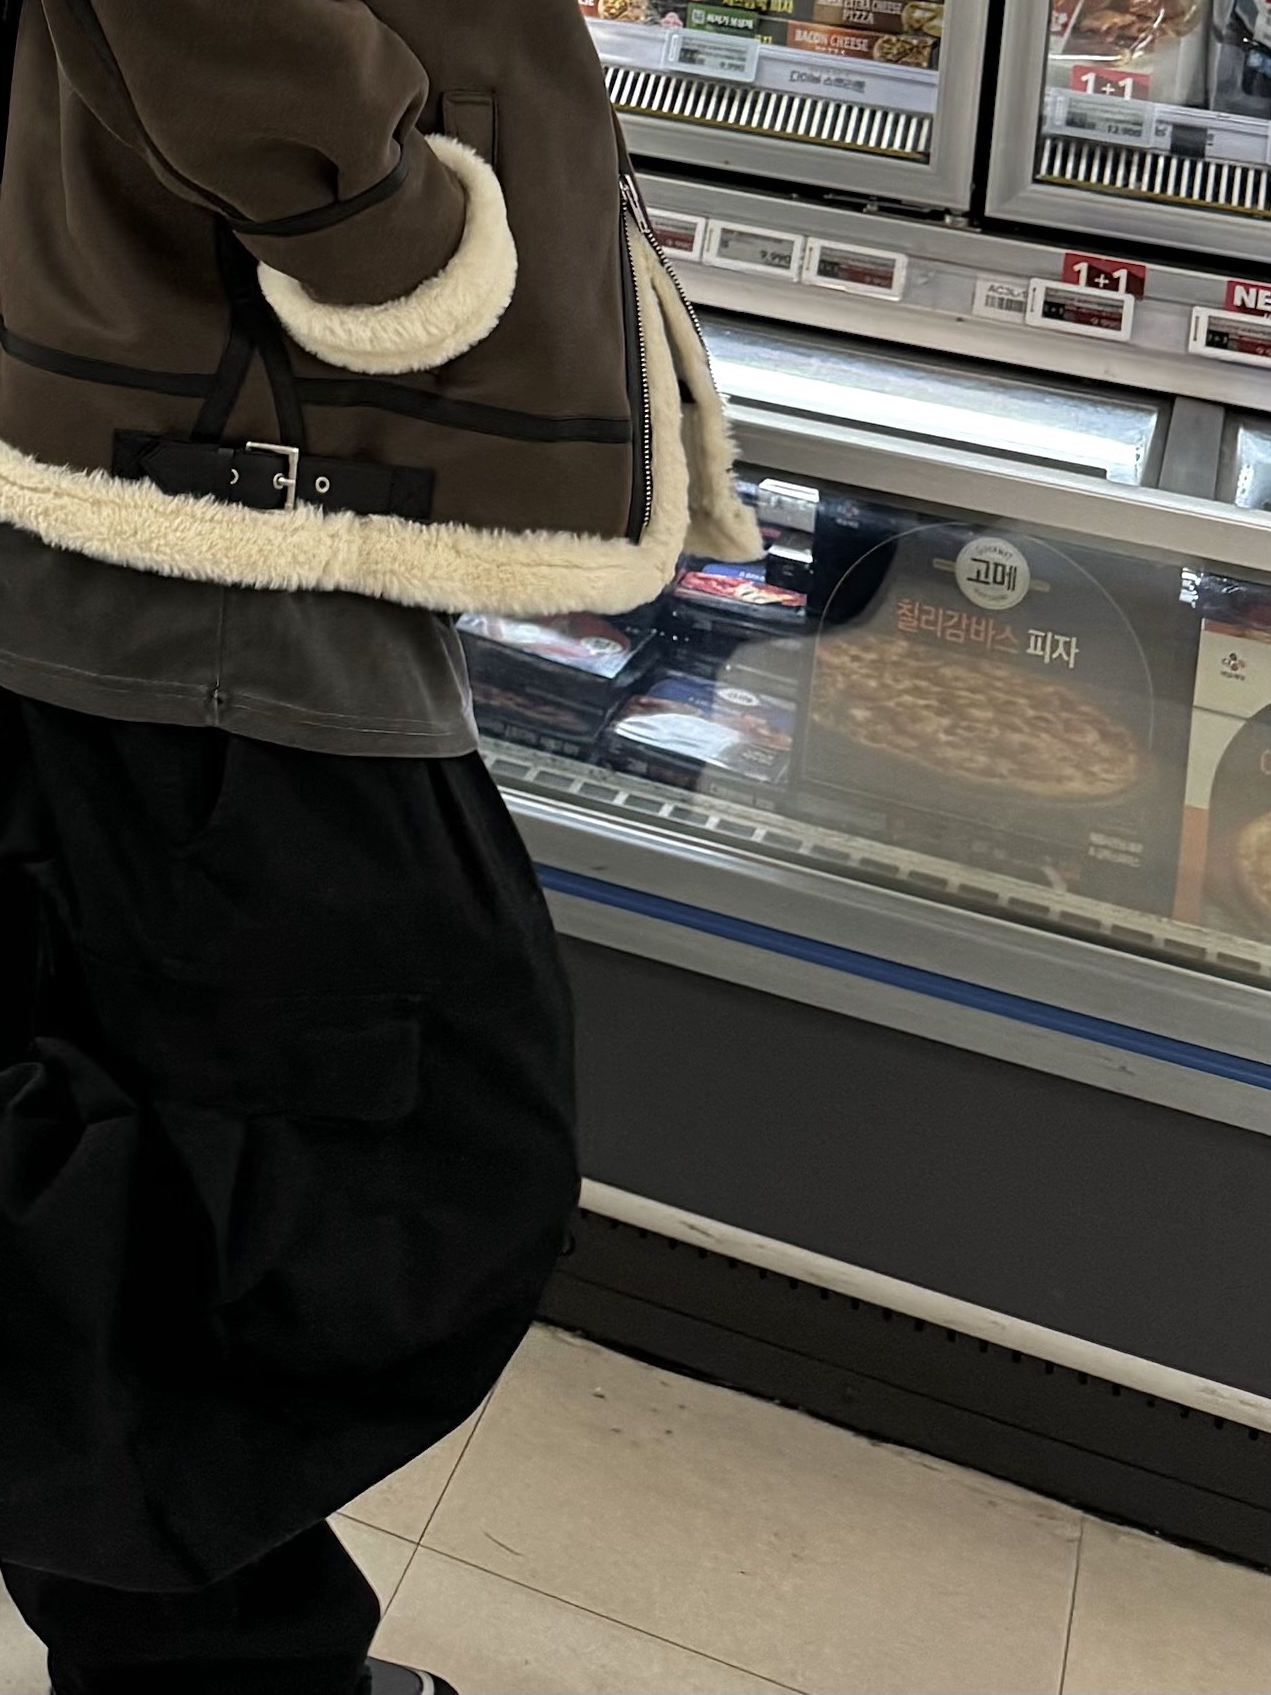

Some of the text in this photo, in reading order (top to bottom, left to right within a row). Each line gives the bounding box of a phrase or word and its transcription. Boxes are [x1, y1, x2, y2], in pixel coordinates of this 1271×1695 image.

[842, 9, 875, 25] PIZZA
[794, 28, 829, 45] BACON
[829, 33, 870, 52] CHEESE
[1072, 261, 1129, 294] 1+1
[1233, 284, 1271, 309] NE
[965, 556, 1018, 592] 고메
[896, 597, 1080, 670] 칠리감바스 피자
